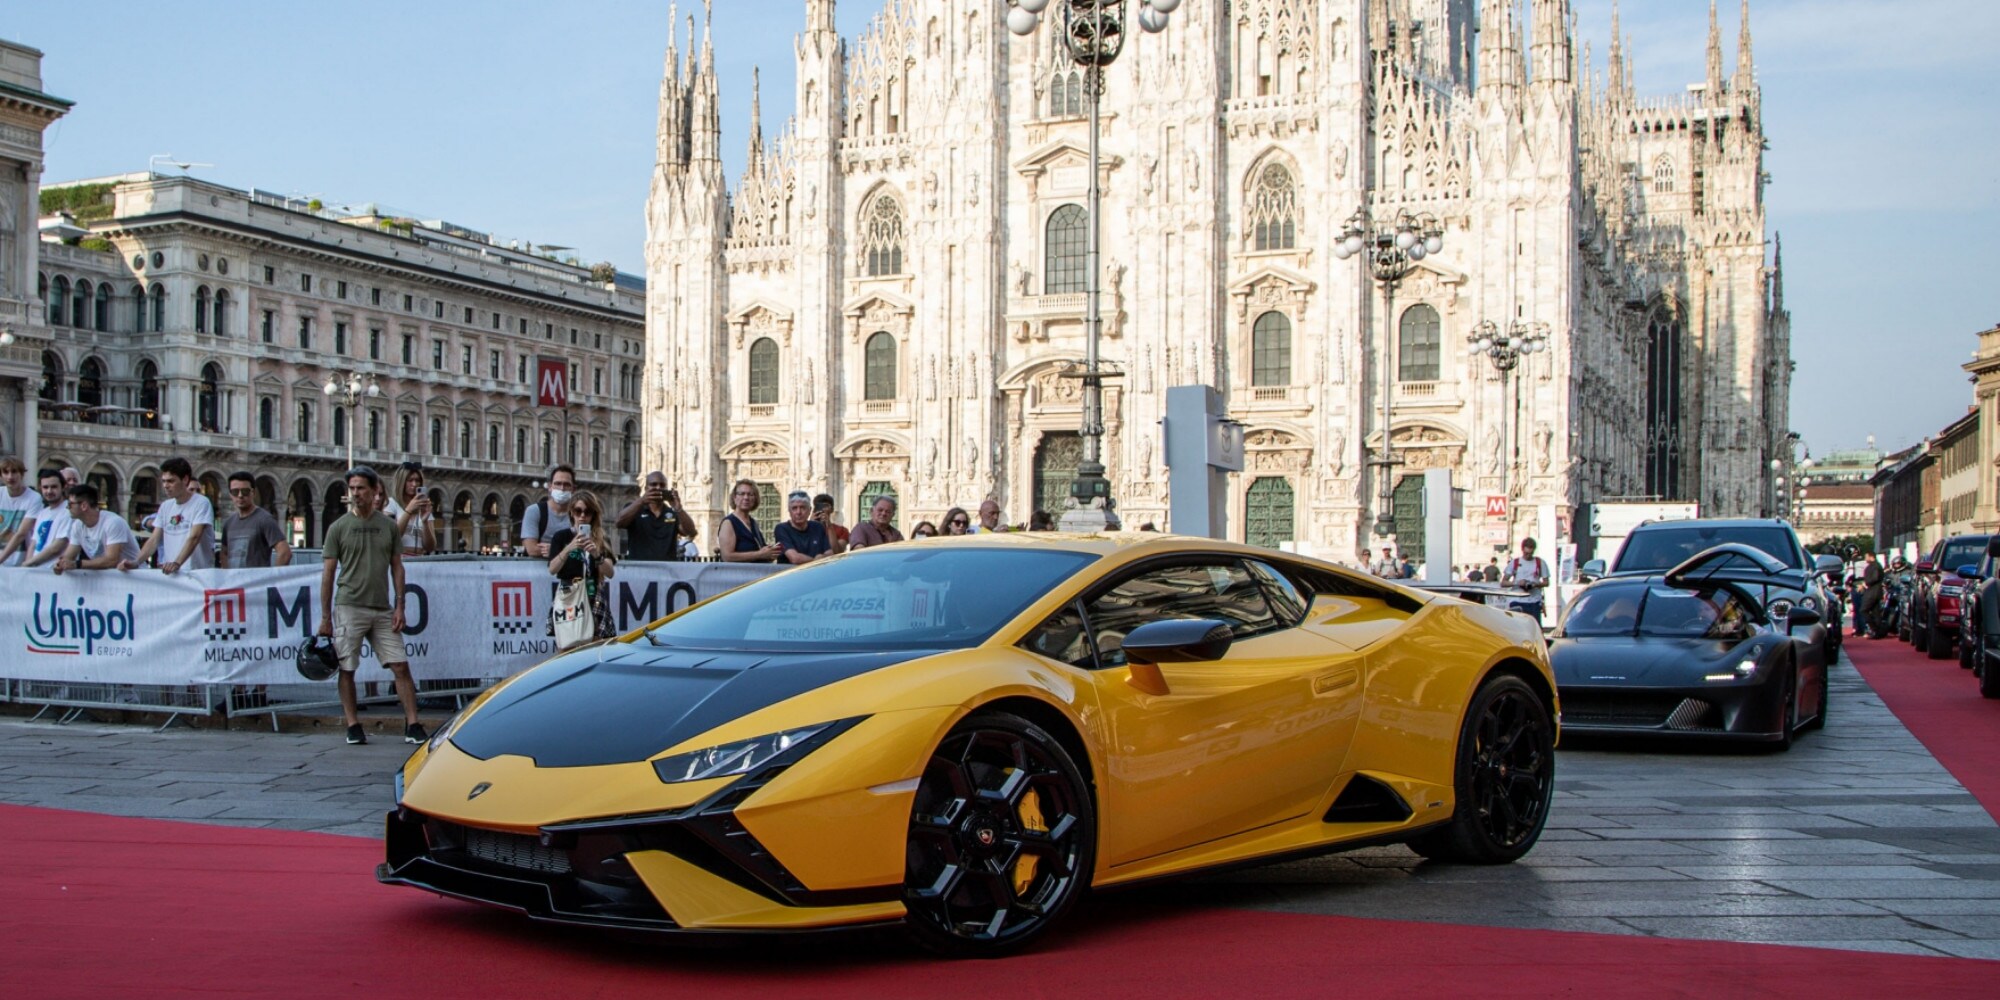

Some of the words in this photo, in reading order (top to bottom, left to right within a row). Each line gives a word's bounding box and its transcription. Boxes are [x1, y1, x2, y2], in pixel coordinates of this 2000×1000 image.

[541, 369, 565, 405] M
[1487, 498, 1506, 513] M
[267, 583, 429, 639] MO
[766, 597, 886, 613] RECCIAROSSA
[33, 592, 134, 655] Unipol
[776, 628, 810, 640] TRENO
[813, 627, 862, 641] UFFICIALE
[97, 645, 133, 657] GRUPPO
[205, 645, 264, 662] MILANO
[268, 645, 301, 660] MON
[493, 639, 549, 655] MILANO
